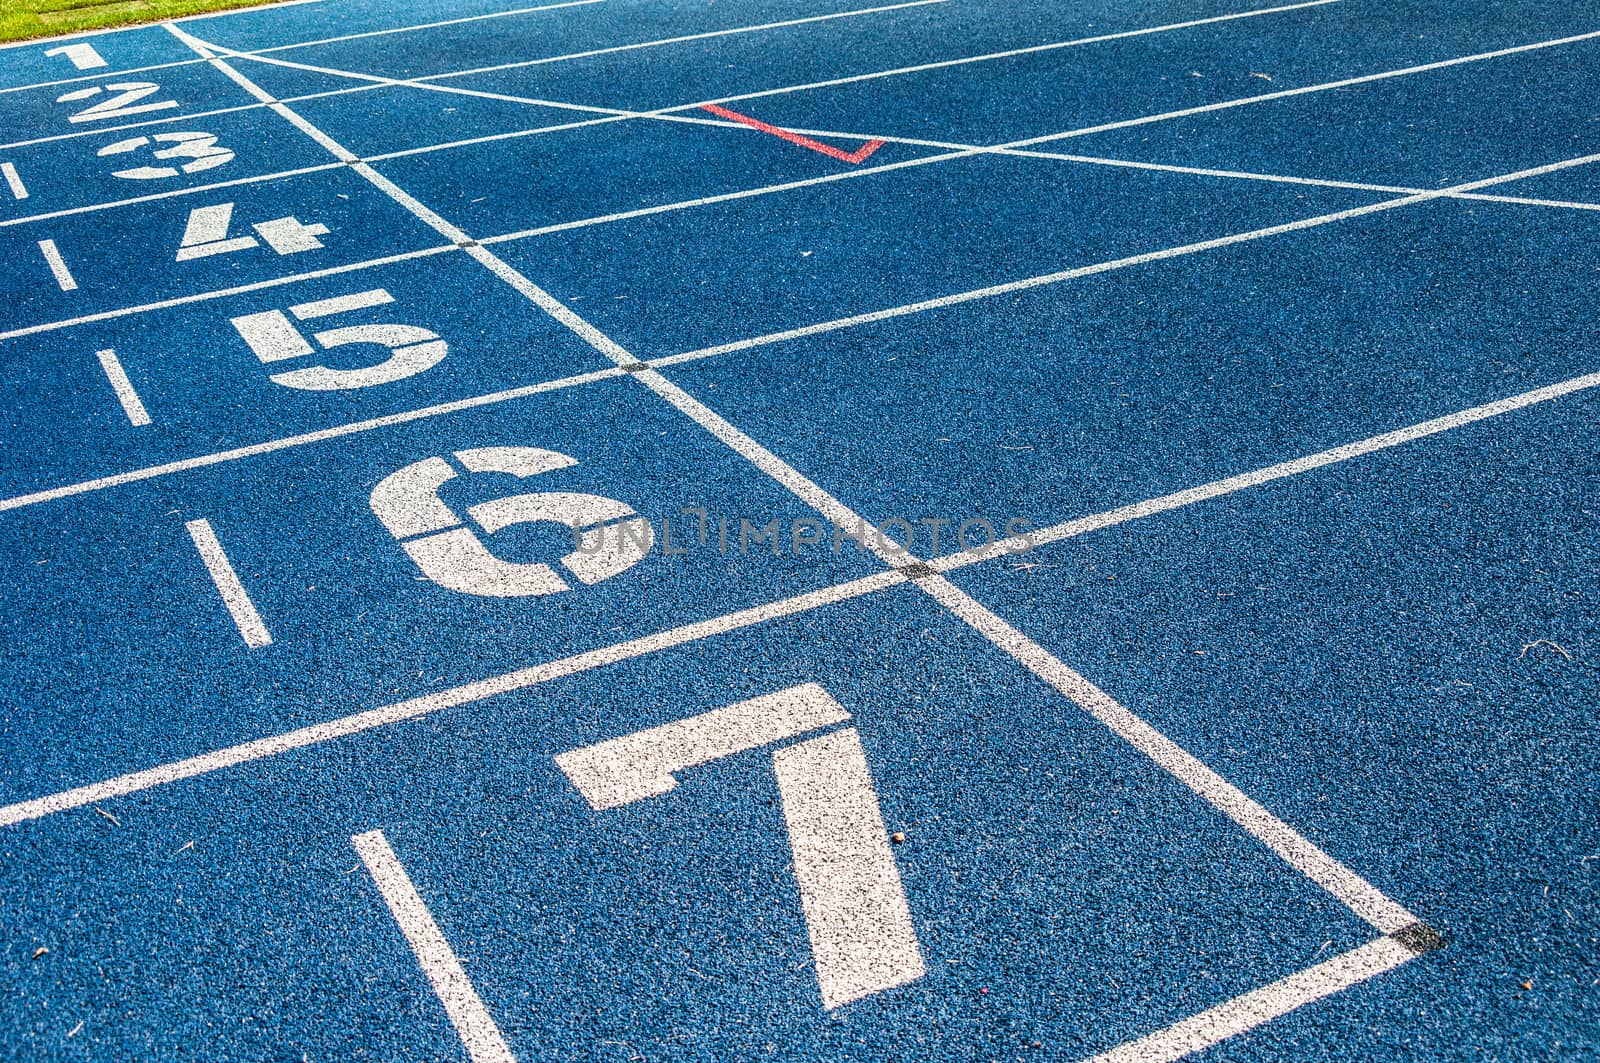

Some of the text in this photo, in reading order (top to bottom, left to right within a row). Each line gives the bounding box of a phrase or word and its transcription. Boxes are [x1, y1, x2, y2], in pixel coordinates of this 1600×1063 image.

[45, 43, 107, 70] 1
[56, 81, 179, 123] 2
[97, 131, 235, 179] 3
[176, 202, 329, 262] 4
[231, 289, 448, 391] 5
[369, 446, 653, 598] 6
[554, 683, 926, 1010] 7
